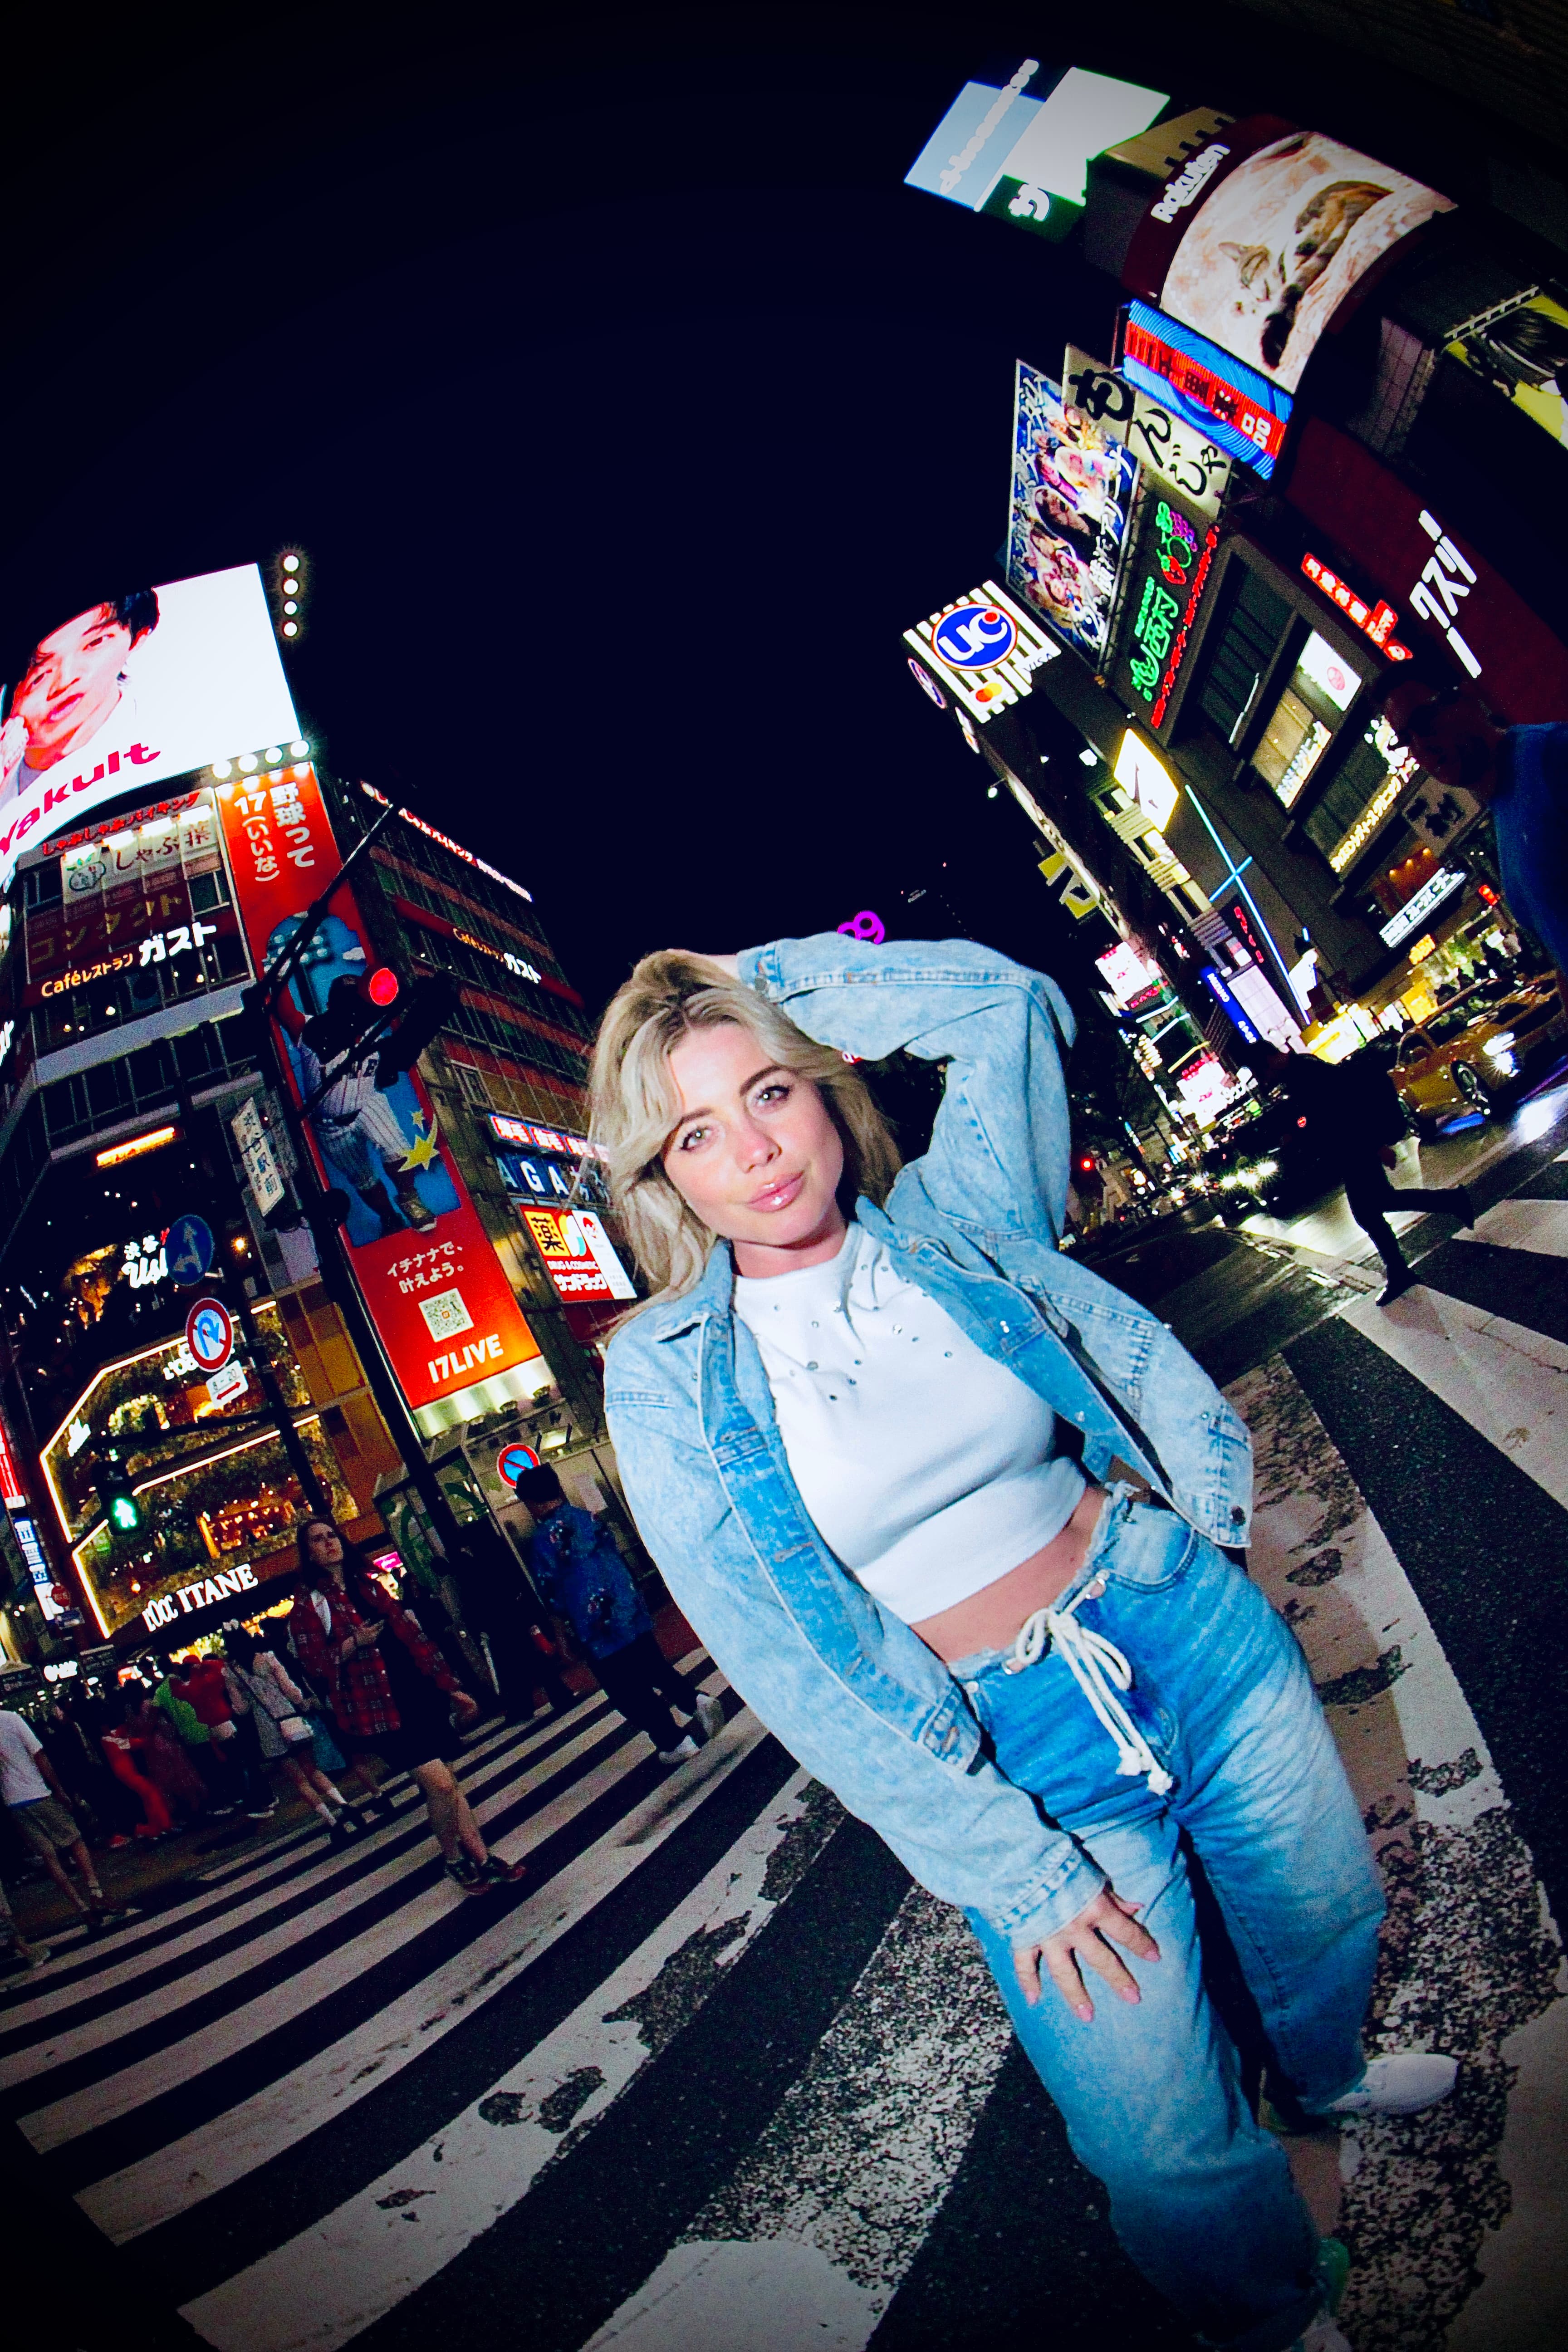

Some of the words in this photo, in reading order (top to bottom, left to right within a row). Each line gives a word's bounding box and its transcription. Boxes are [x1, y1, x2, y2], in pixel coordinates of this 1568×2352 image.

[1151, 144, 1231, 223] Rakuten
[1069, 368, 1226, 496] もんじゃ
[1409, 535, 1478, 630] クスリ
[1023, 654, 1054, 673] VISA
[0, 743, 161, 856] Yakult
[271, 782, 314, 867] 野球って
[30, 893, 182, 965] コンタクト
[139, 921, 217, 967] ガスト
[531, 1217, 564, 1251] 薬
[387, 1241, 463, 1277] イチナナで、
[399, 1263, 464, 1294] 叶えよう。
[554, 1273, 608, 1291] サンドラッグ
[427, 1334, 504, 1383] 17LIVE
